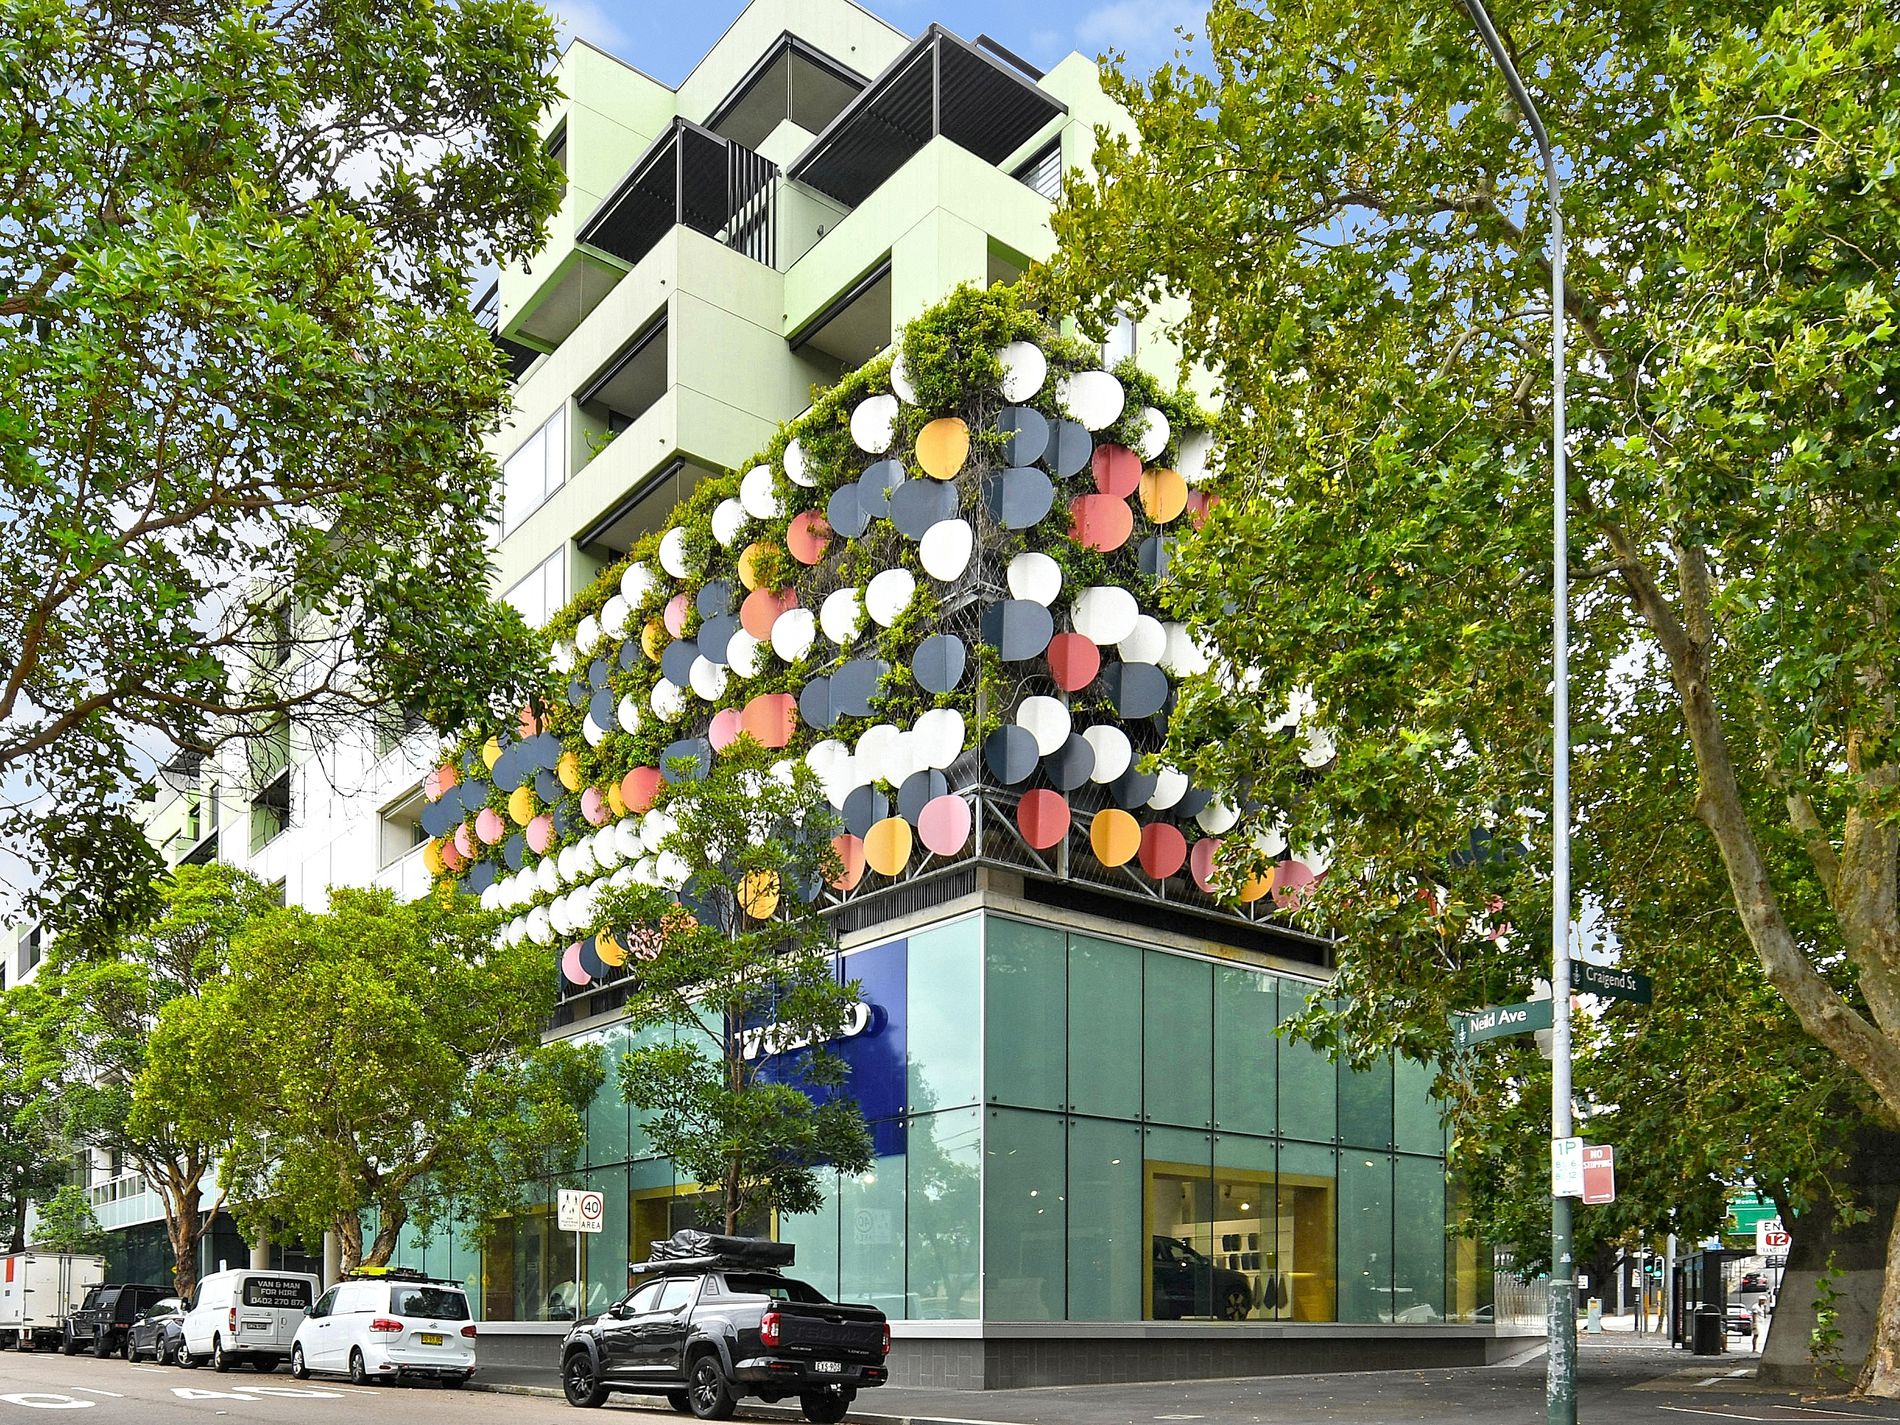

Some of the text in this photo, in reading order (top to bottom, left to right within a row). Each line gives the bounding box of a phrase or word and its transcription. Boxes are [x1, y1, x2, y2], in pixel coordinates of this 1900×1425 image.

[1586, 966, 1636, 991] Craigend St
[1470, 1009, 1527, 1033] Neild Ave
[1558, 1141, 1576, 1155] 1P
[1590, 1150, 1603, 1159] NO
[585, 1201, 598, 1213] 40
[581, 1221, 600, 1229] AREA
[1768, 1233, 1786, 1245] T2
[170, 1386, 345, 1400] 40
